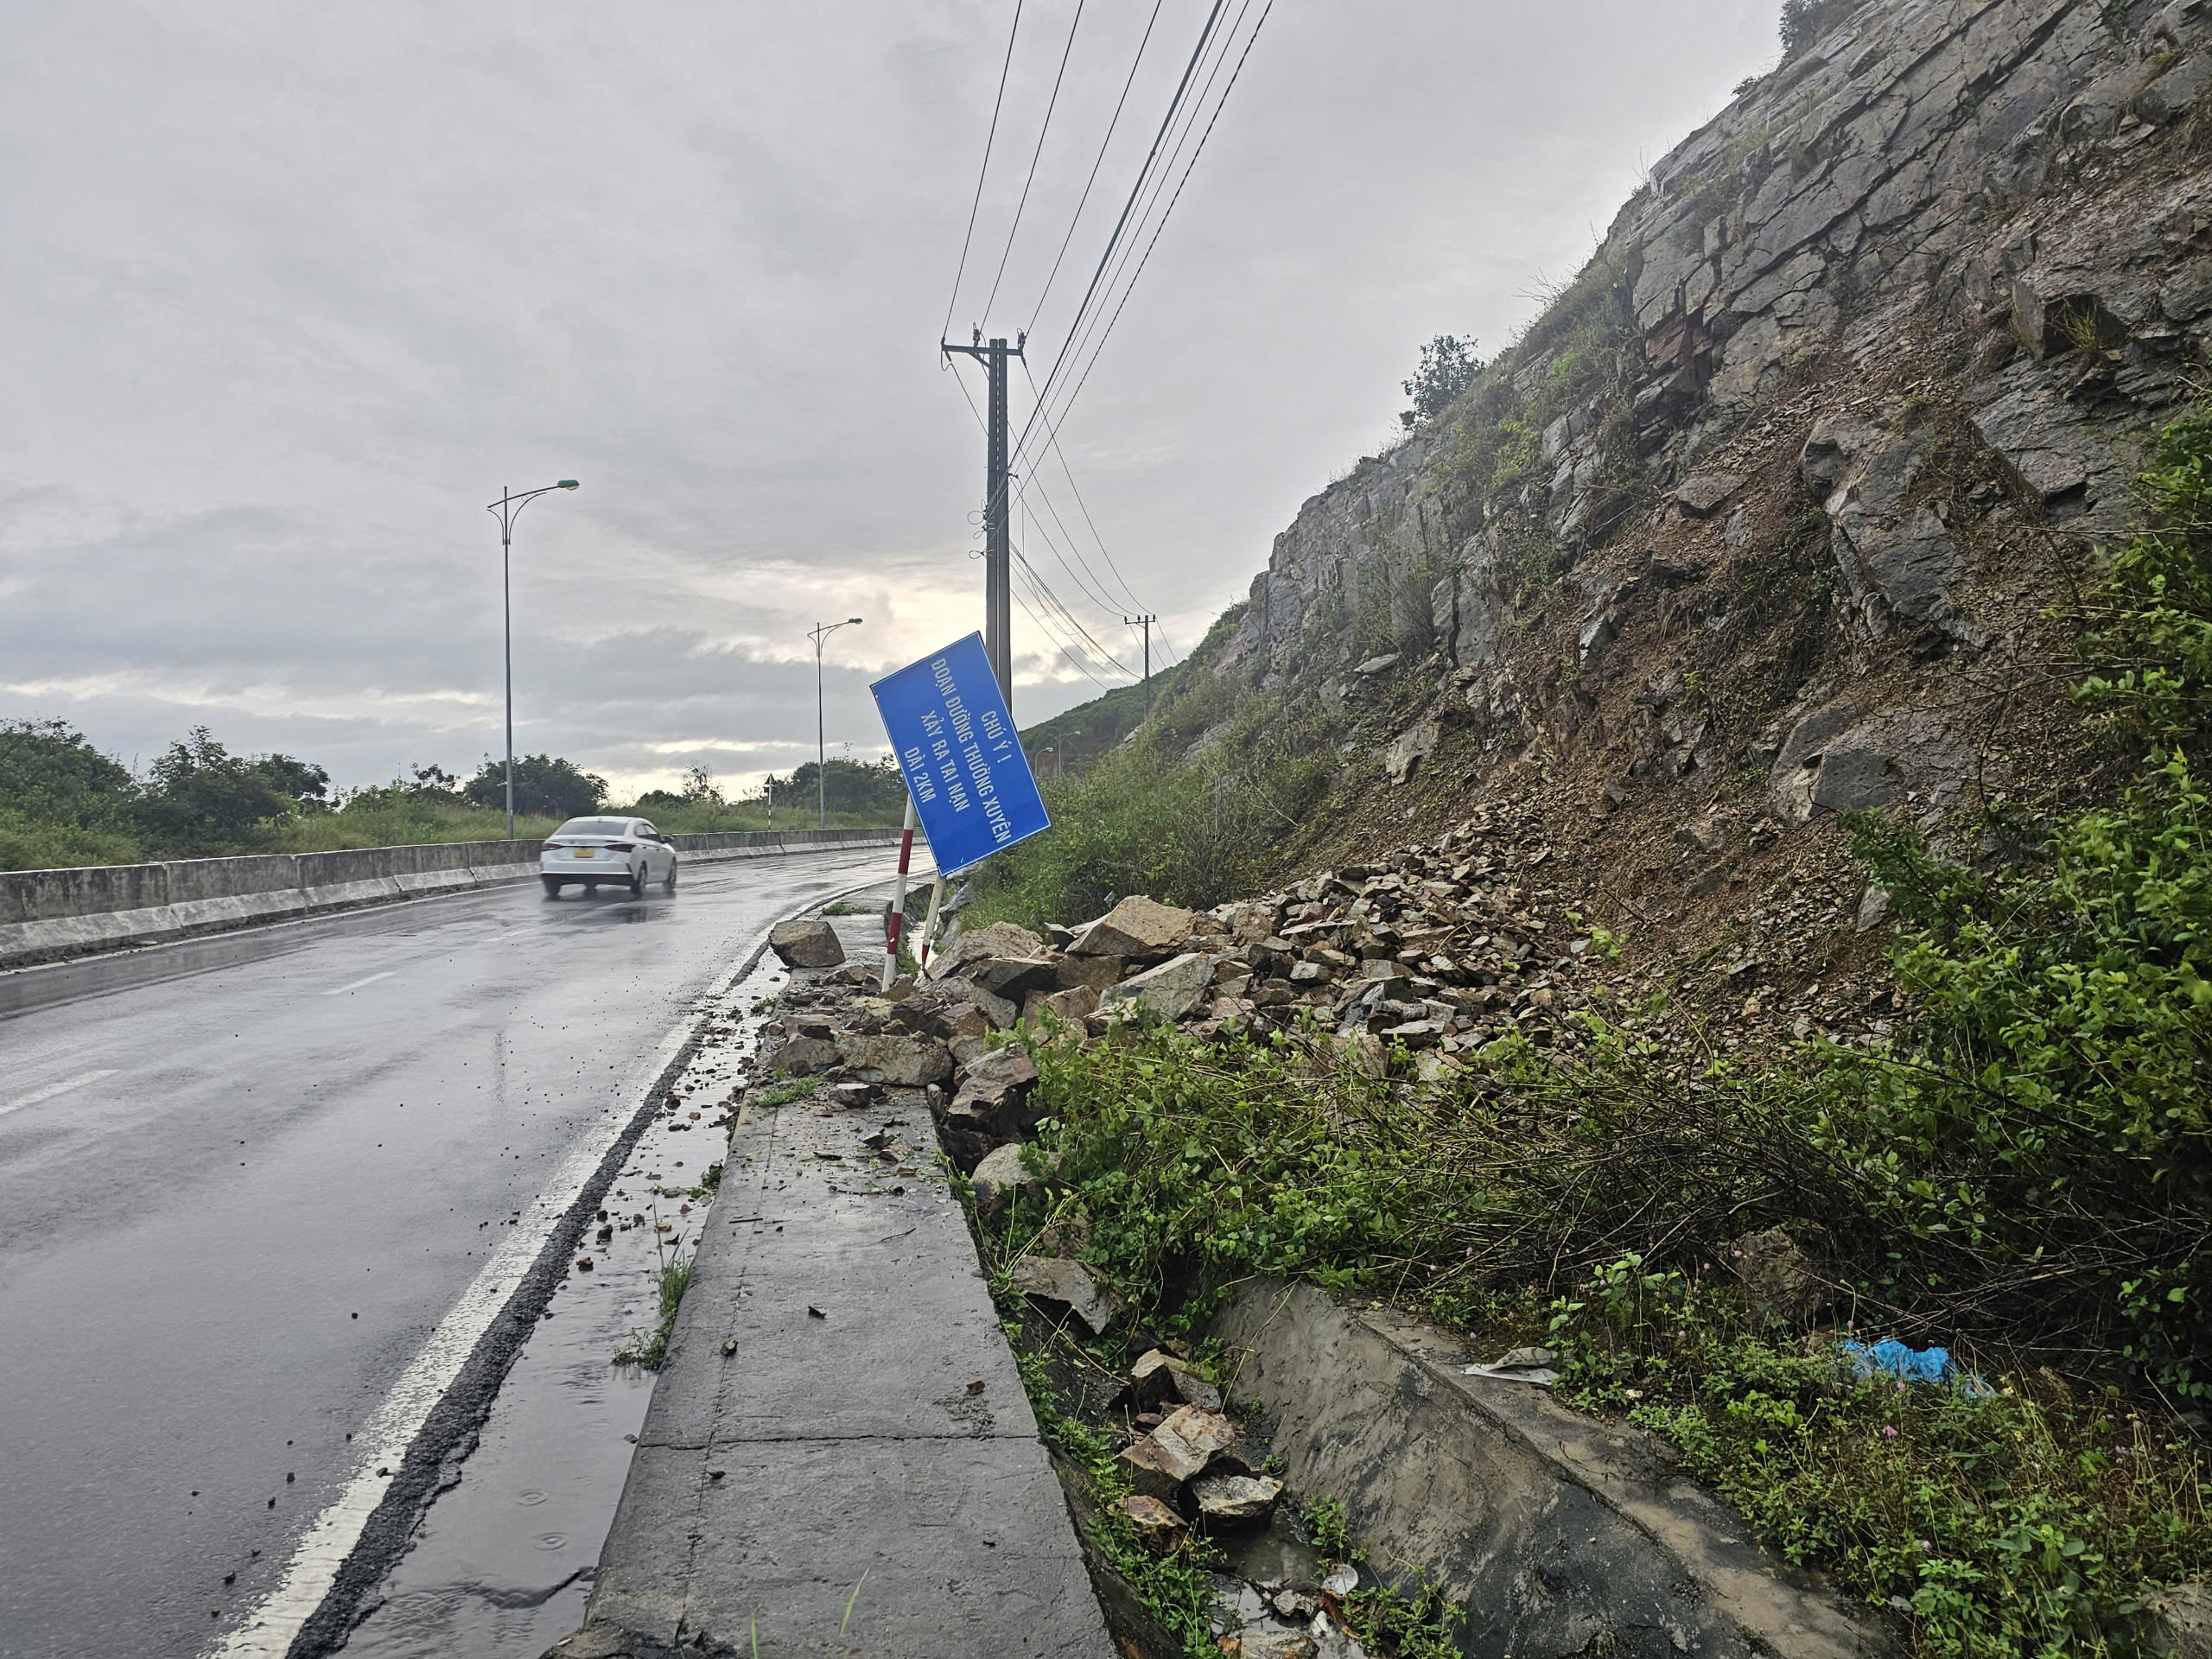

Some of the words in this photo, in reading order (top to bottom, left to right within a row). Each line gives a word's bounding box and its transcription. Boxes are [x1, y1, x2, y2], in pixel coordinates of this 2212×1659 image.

[921, 710, 944, 736] XẢY
[982, 711, 1007, 739] CHÚ
[931, 658, 956, 696] ĐOẠN
[945, 696, 973, 743] ĐƯỜNG
[963, 742, 994, 797] THƯỜNG
[982, 796, 1011, 842] XUYÊN
[932, 740, 950, 760] RA
[993, 741, 1012, 751] Ý
[997, 754, 1012, 763] !
[905, 747, 925, 771] DÀI
[940, 760, 958, 783] TAI
[913, 772, 936, 803] 2KM
[948, 783, 969, 811] NẠN
